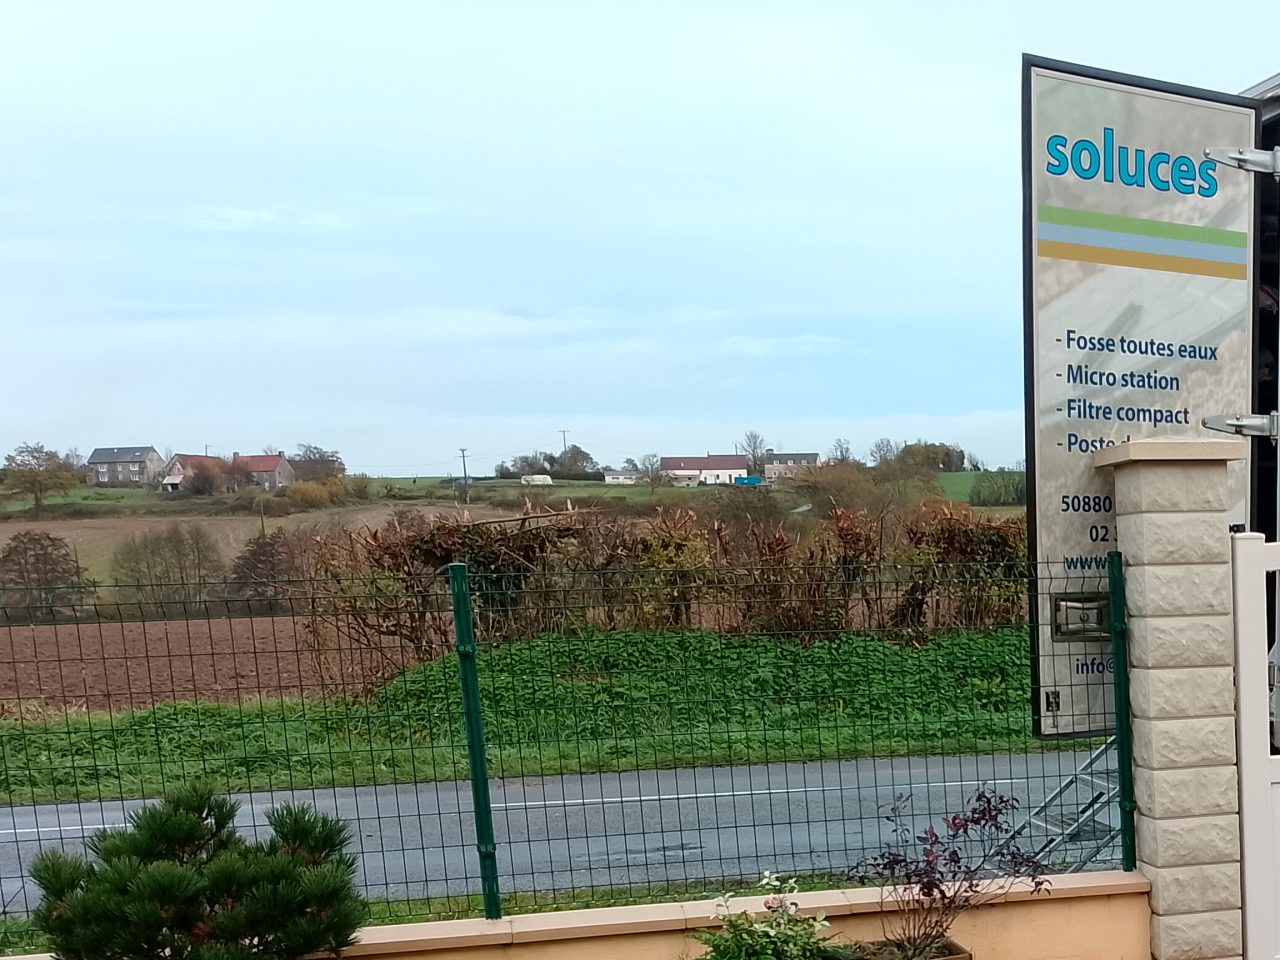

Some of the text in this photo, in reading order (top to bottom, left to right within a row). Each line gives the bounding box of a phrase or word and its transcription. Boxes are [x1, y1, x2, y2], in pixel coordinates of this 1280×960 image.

[1046, 127, 1219, 198] soluces
[1066, 329, 1116, 352] Fosse
[1119, 336, 1174, 357] toutes
[1178, 342, 1218, 361] eaux
[1066, 364, 1117, 387] Micro
[1120, 370, 1180, 391] station
[1067, 399, 1112, 420] Filtre
[1116, 405, 1190, 428] compact
[1061, 495, 1113, 513] 50880
[1089, 525, 1109, 542] 02
